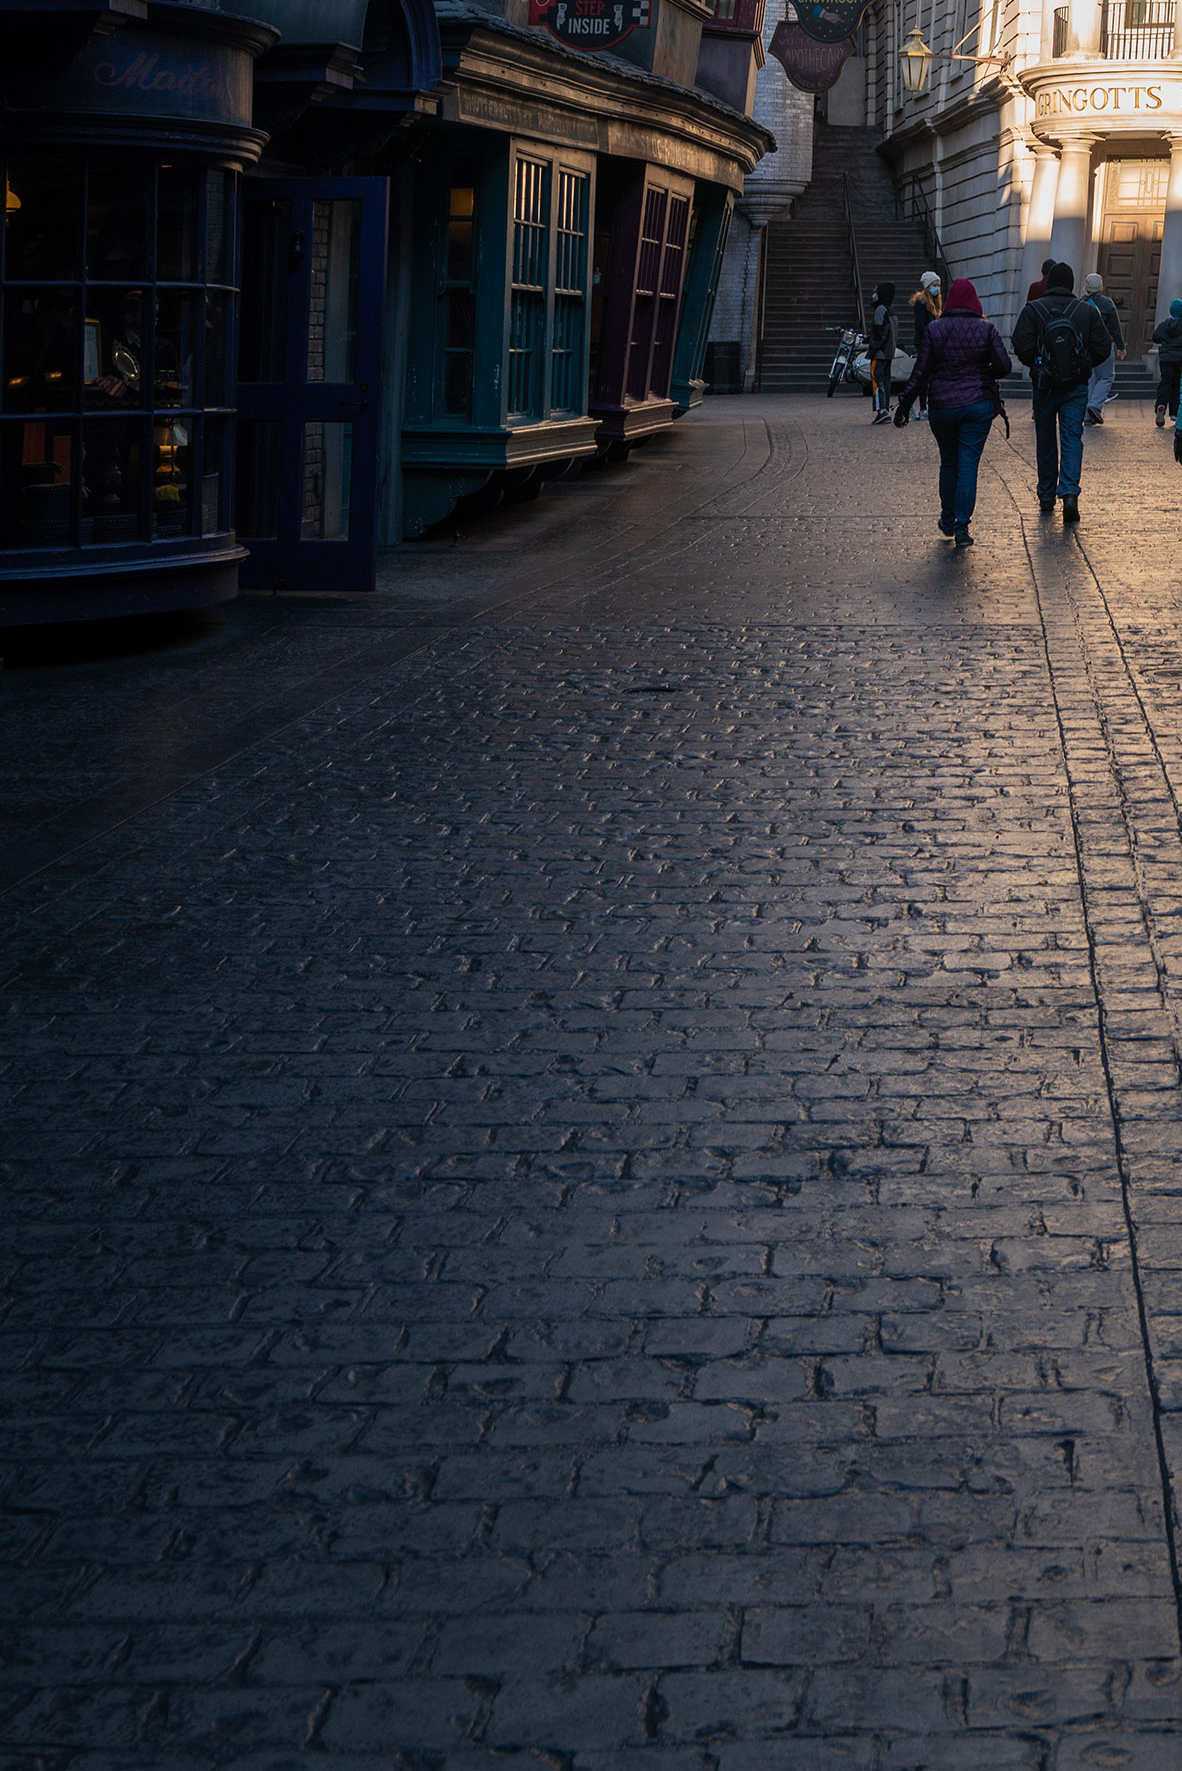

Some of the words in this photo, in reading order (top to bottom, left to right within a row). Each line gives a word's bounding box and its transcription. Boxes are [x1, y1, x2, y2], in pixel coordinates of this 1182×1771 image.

[575, 0, 605, 16] STEP
[568, 18, 610, 35] INSIDE
[1036, 85, 1162, 116] GRINGOTTS
